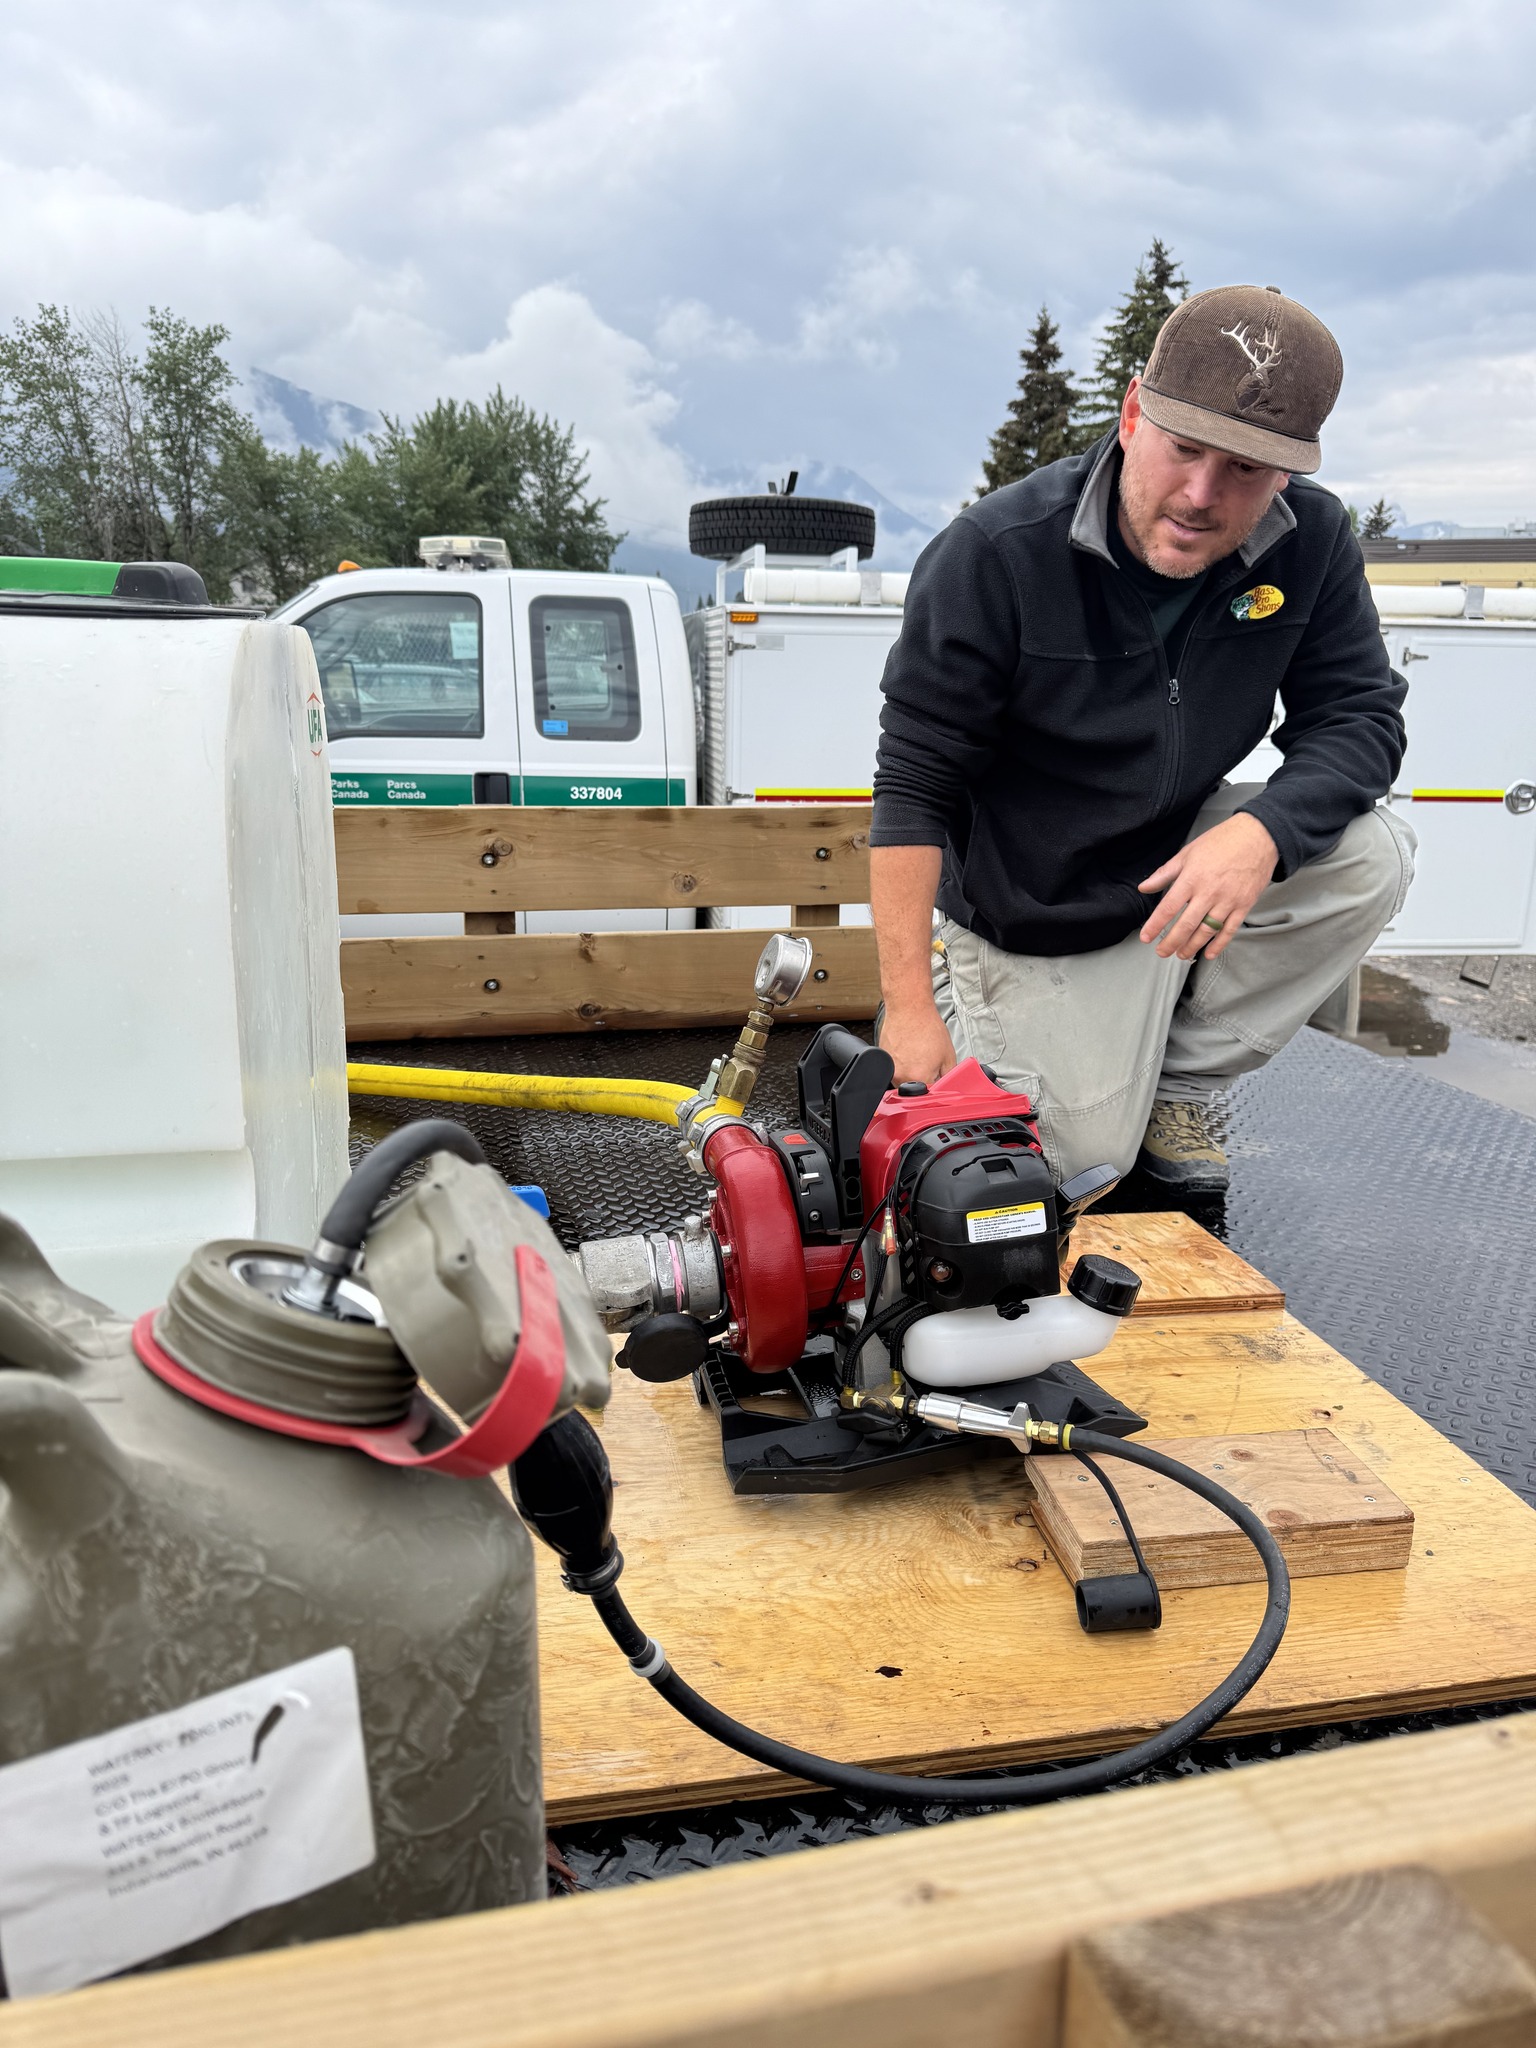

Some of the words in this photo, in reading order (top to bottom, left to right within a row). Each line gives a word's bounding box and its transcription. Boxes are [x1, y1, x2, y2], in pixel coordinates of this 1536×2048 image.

[1254, 587, 1275, 597] Bass
[1255, 596, 1270, 605] Pro
[1255, 602, 1281, 614] Shops
[307, 709, 324, 743] UFA
[331, 779, 360, 789] Parks
[387, 780, 417, 789] Parcs
[331, 790, 369, 799] Canada
[387, 790, 426, 800] Canada
[570, 786, 622, 800] 337804
